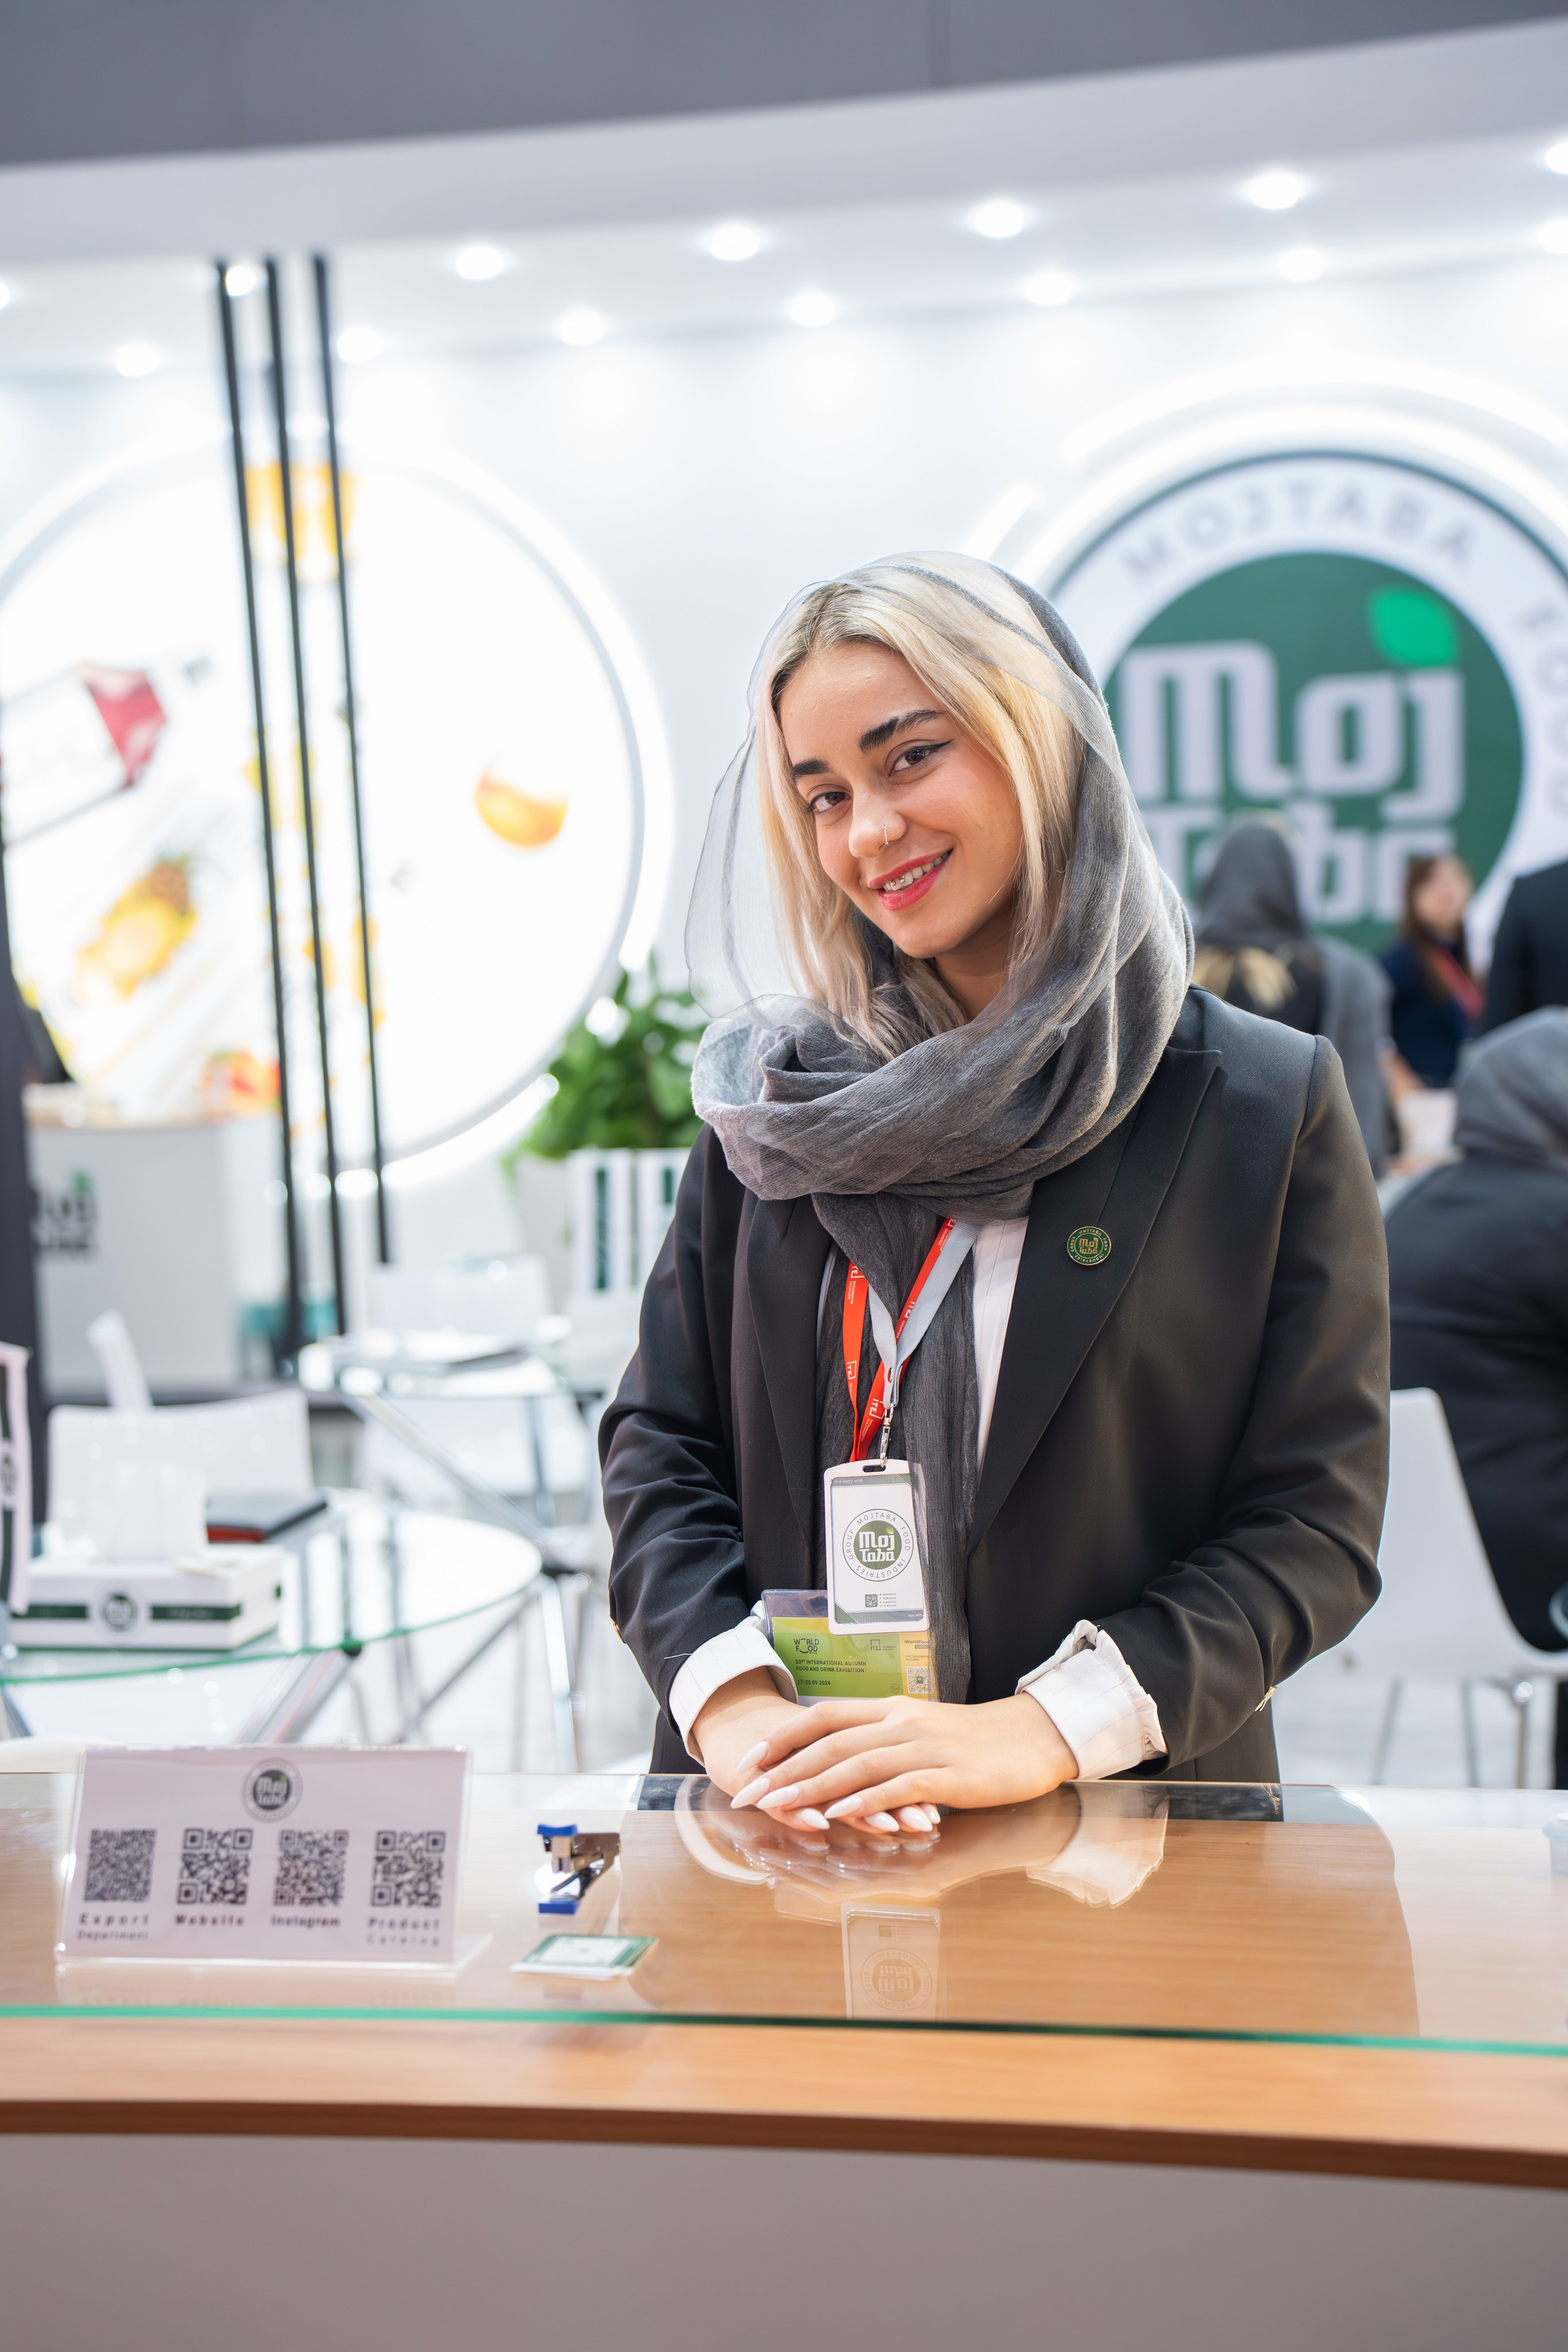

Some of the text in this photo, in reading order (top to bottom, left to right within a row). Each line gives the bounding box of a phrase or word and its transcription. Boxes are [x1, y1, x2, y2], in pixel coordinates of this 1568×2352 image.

[1122, 637, 1466, 822] Moj
[857, 1512, 896, 1525] MOJTABA
[859, 1531, 895, 1551] Moj
[900, 1526, 910, 1551] FOOD
[859, 1548, 895, 1562] Taba
[856, 1559, 906, 1578] INDUSTRIES
[79, 1912, 149, 1928] Export
[176, 1913, 245, 1926] Website
[271, 1915, 341, 1929] Instagram
[368, 1917, 440, 1931] Product
